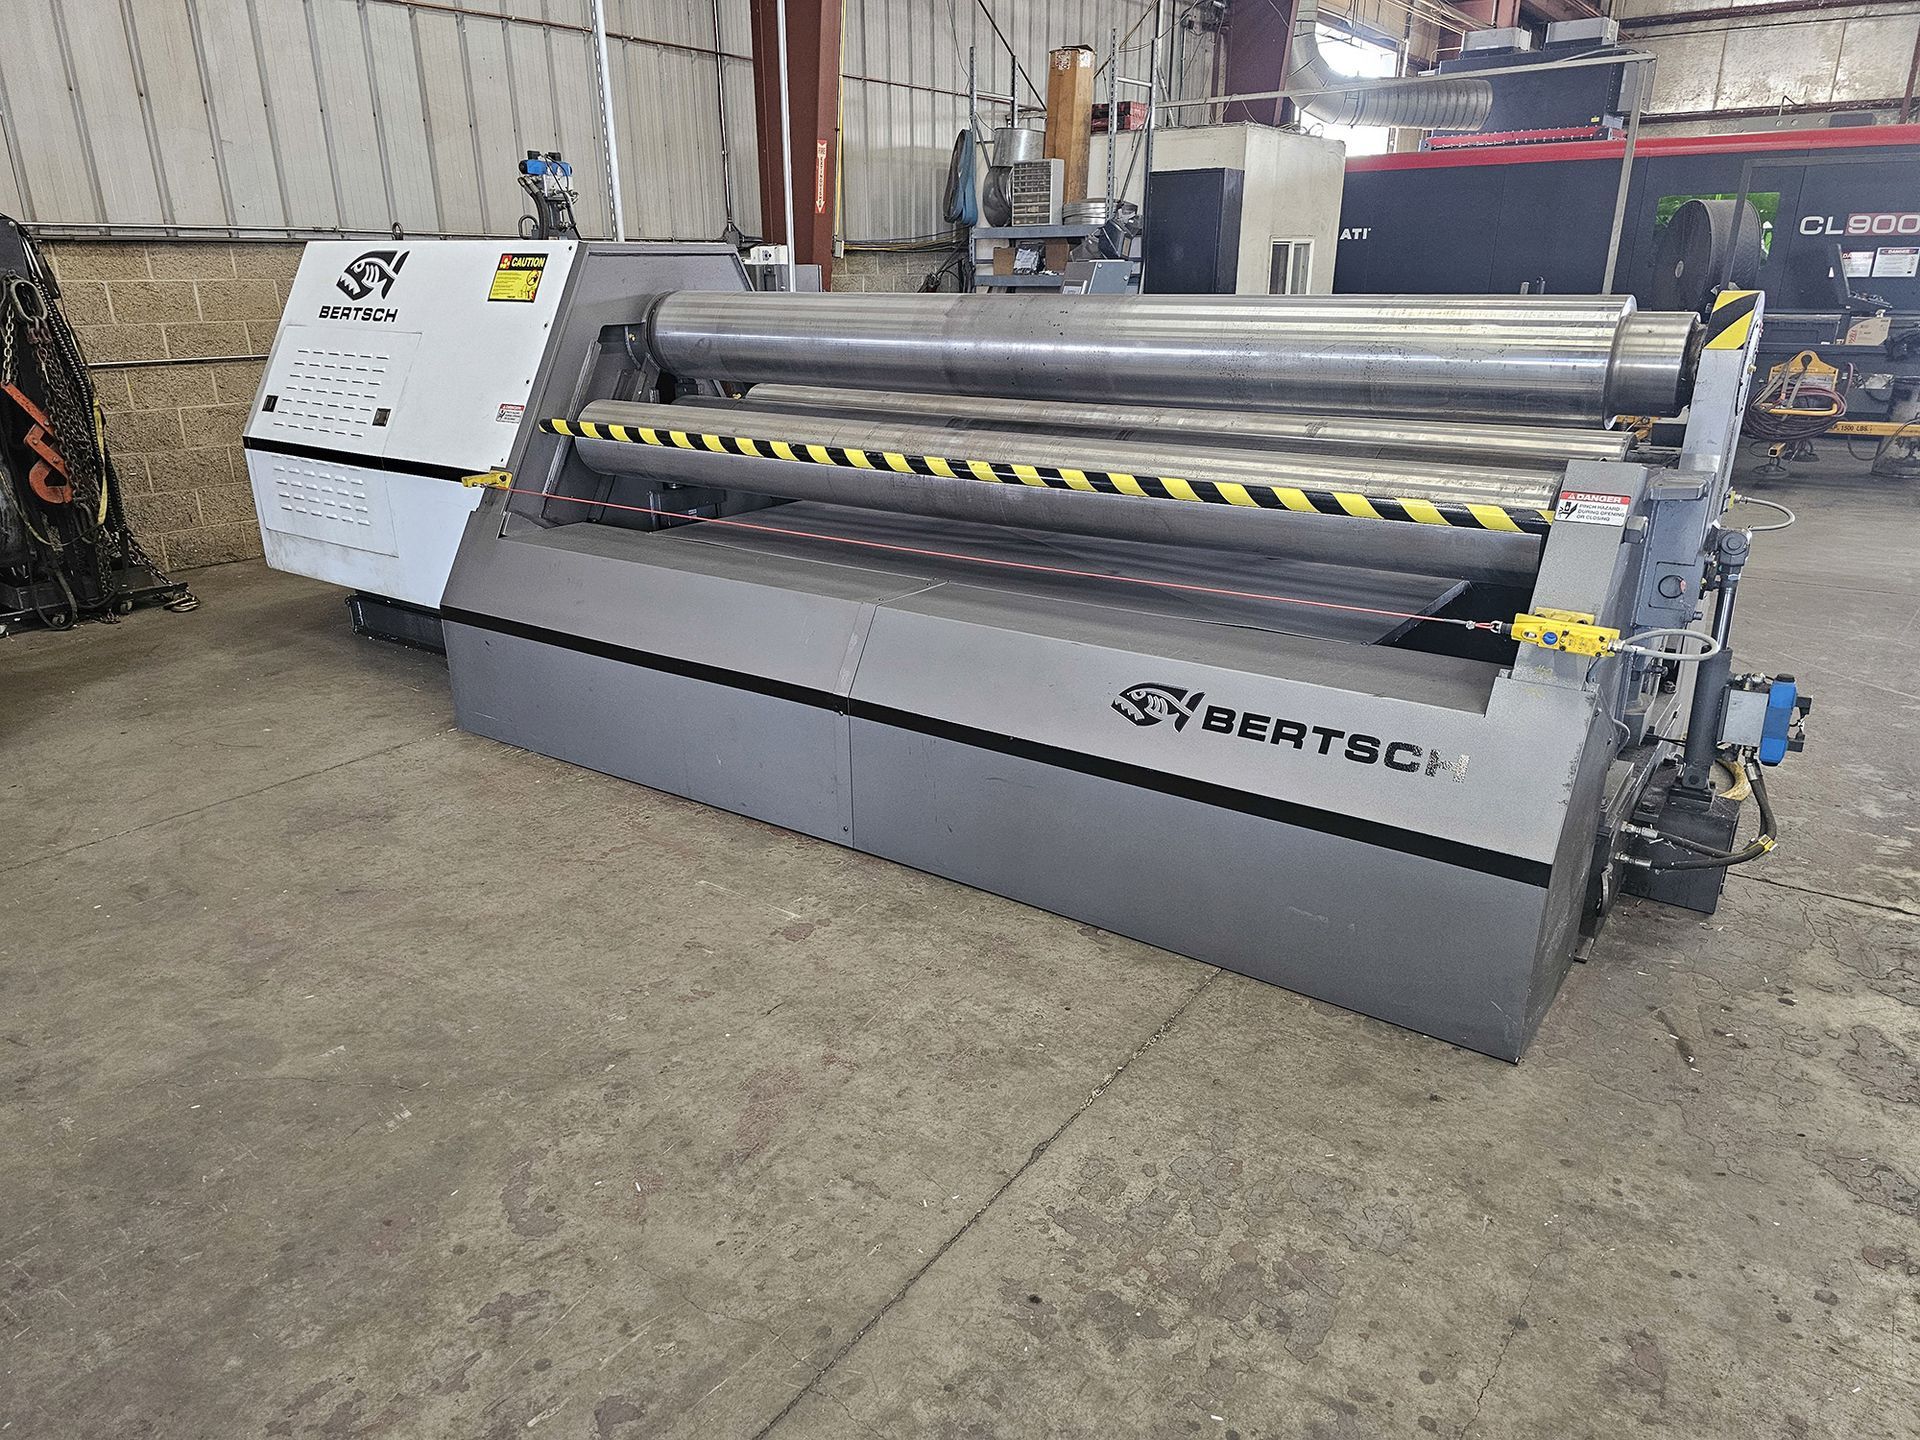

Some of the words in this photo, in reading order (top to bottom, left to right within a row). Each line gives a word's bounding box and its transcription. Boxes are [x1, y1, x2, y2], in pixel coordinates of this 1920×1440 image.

[1799, 215, 1920, 235] CL900
[511, 256, 546, 268] CAUTION
[318, 305, 399, 323] BERTSCH
[1576, 494, 1621, 504] DANGER
[1202, 704, 1471, 784] BERTSCH
